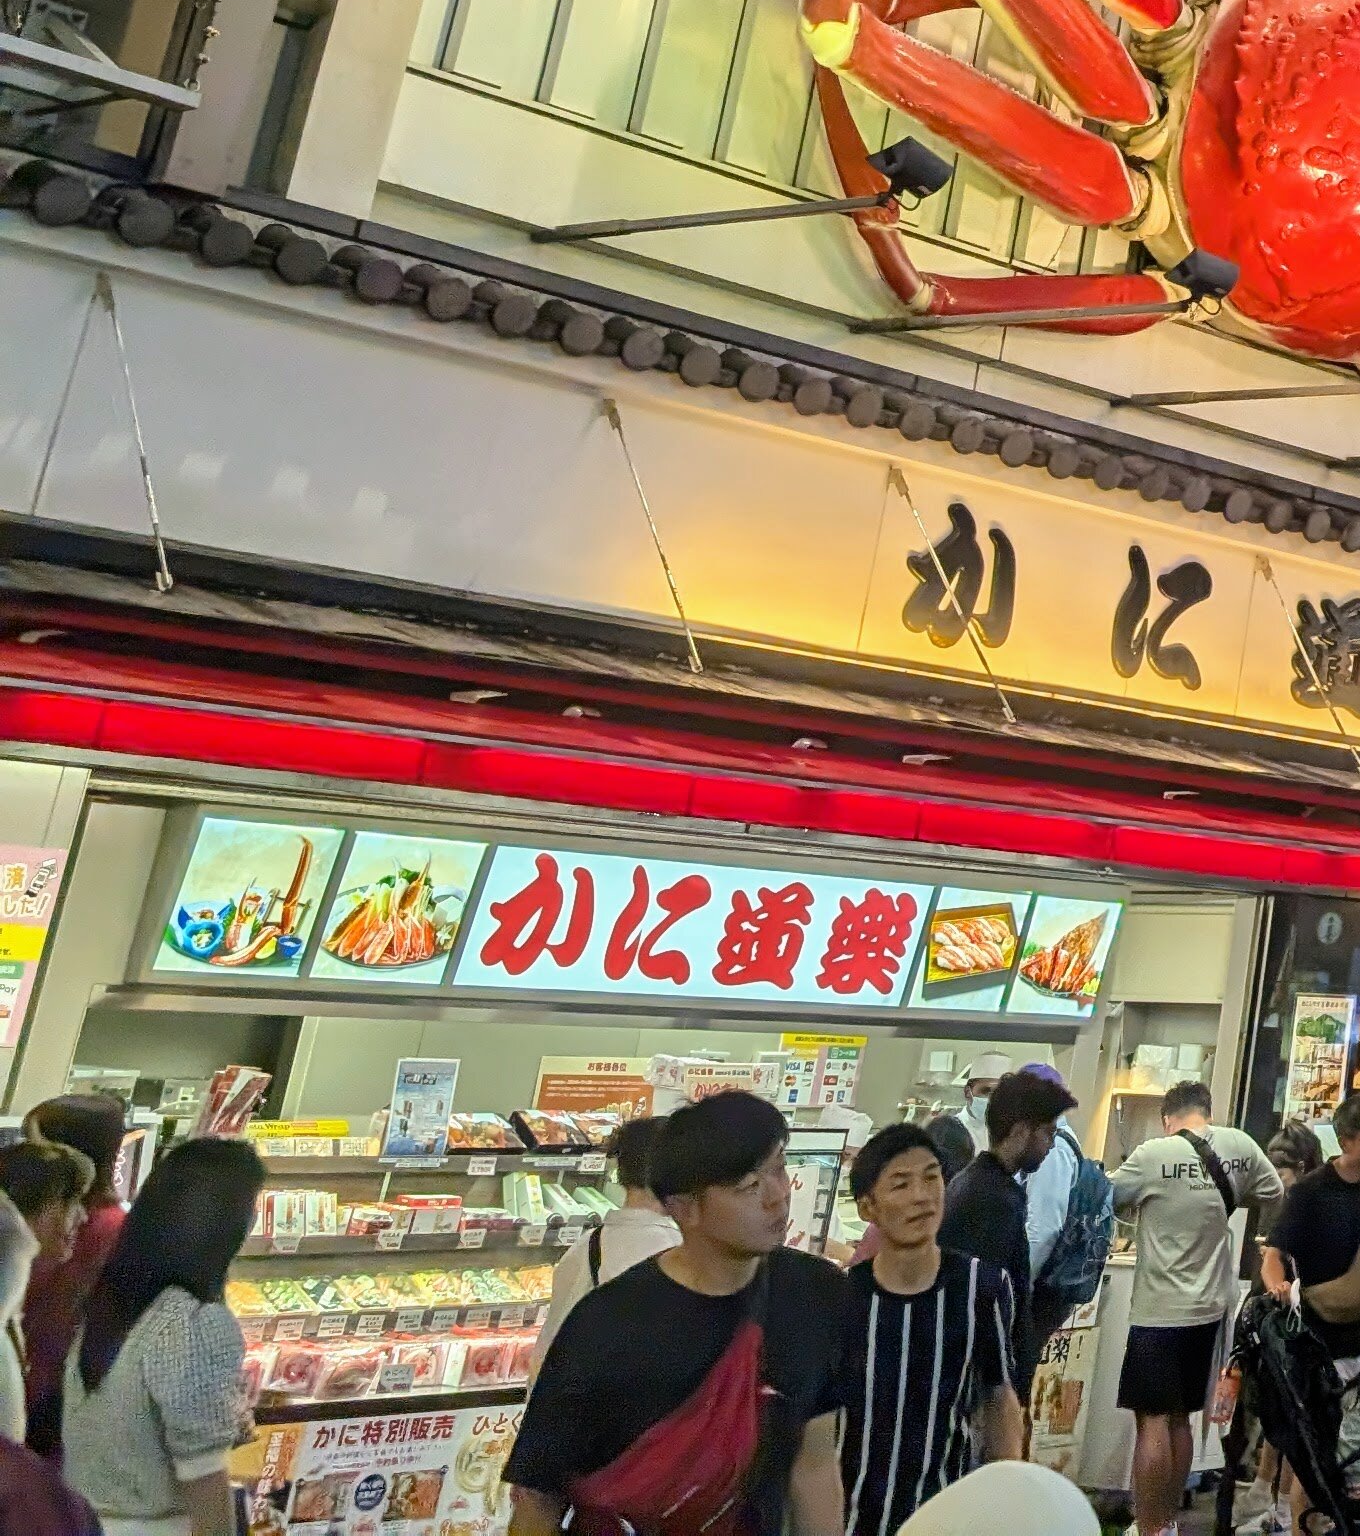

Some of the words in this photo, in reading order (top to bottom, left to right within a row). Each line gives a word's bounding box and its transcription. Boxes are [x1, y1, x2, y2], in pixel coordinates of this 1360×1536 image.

[312, 1414, 456, 1448] かに特別販売
